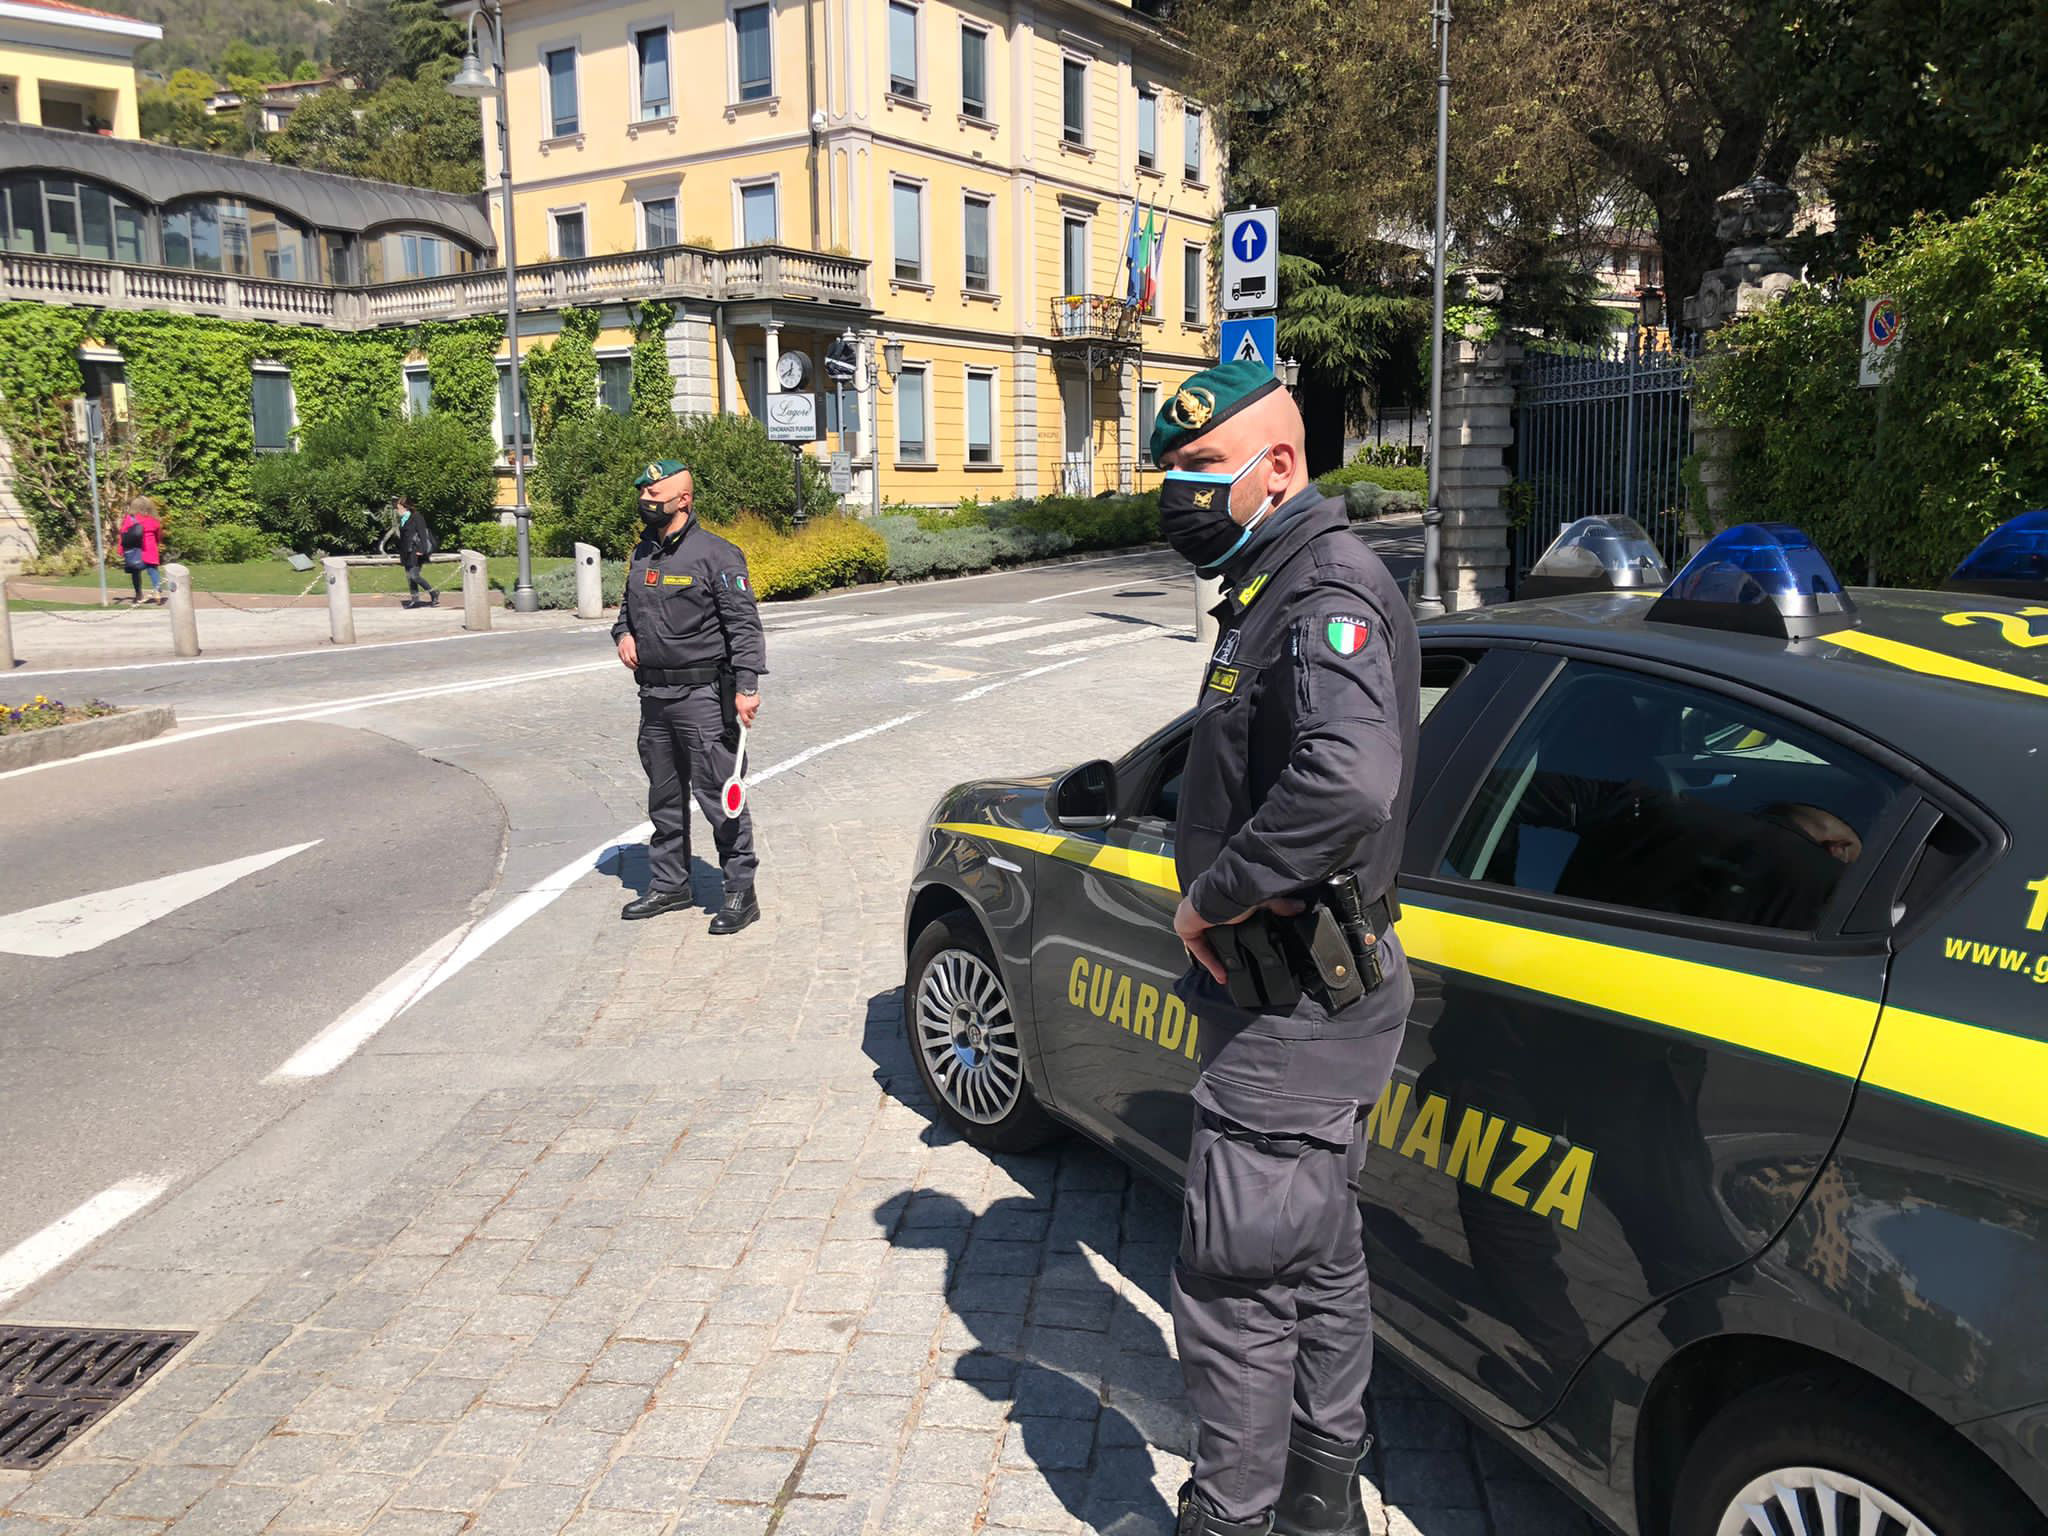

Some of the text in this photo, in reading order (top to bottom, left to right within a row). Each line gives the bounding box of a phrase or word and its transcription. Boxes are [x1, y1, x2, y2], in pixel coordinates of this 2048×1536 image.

[1330, 615, 1367, 628] ITALIA
[1068, 955, 1596, 1231] GUARDI NANZA
